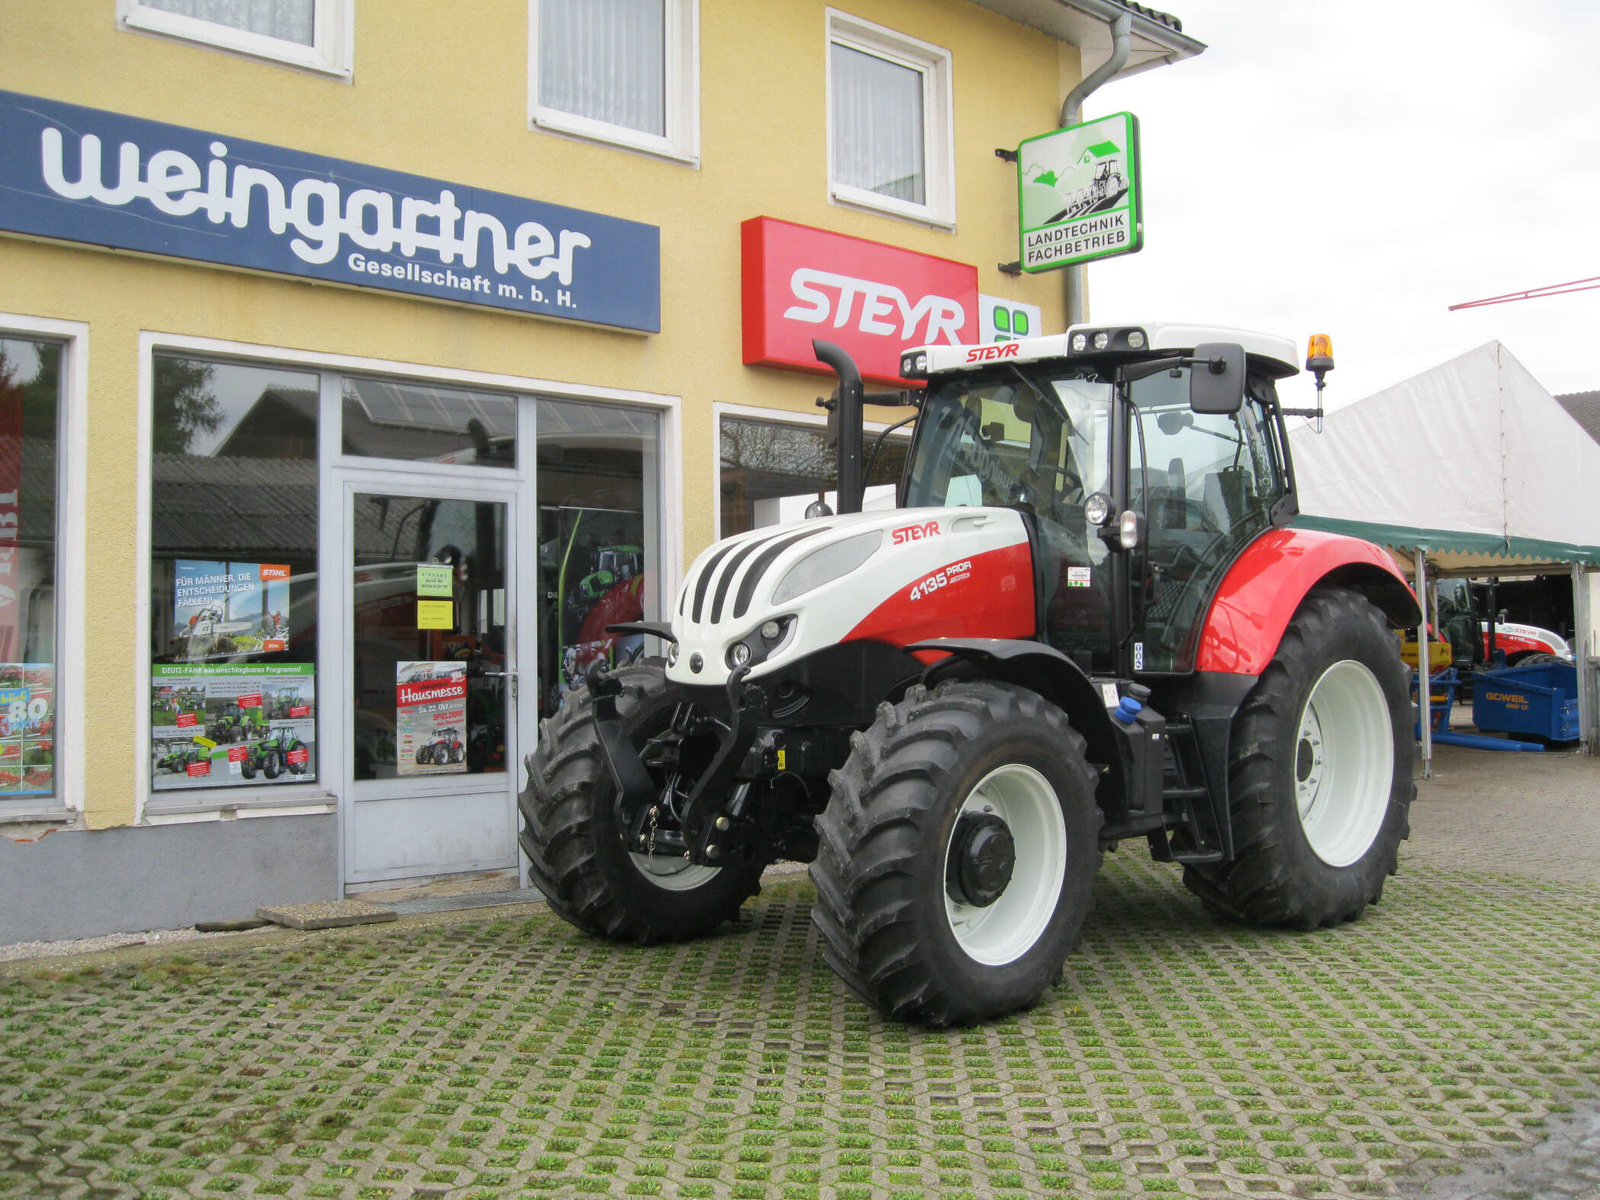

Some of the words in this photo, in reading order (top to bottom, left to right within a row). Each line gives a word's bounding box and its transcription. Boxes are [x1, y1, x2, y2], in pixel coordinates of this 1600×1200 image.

[42, 127, 592, 286] weingartner
[1028, 214, 1124, 248] LANDTECHNIK
[1028, 230, 1126, 263] FACHBETRIEB
[348, 253, 491, 294] Gesellschaft
[498, 282, 524, 300] m.
[531, 285, 550, 304] b.
[557, 289, 578, 308] H.
[784, 268, 965, 346] STEYR
[966, 343, 1020, 363] STEYR
[892, 521, 941, 545] STEYR
[176, 576, 193, 587] FÜR
[238, 573, 252, 581] DIE
[262, 568, 287, 577] STIHL
[910, 572, 948, 601] 4135
[946, 561, 972, 576] PROFI
[177, 582, 256, 597] ENTSCHEIDUNGEN
[178, 597, 213, 608] FÄLLEN!
[216, 666, 265, 675] unschlagbares
[400, 685, 464, 704] Hausmesse
[9, 697, 48, 722] 80
